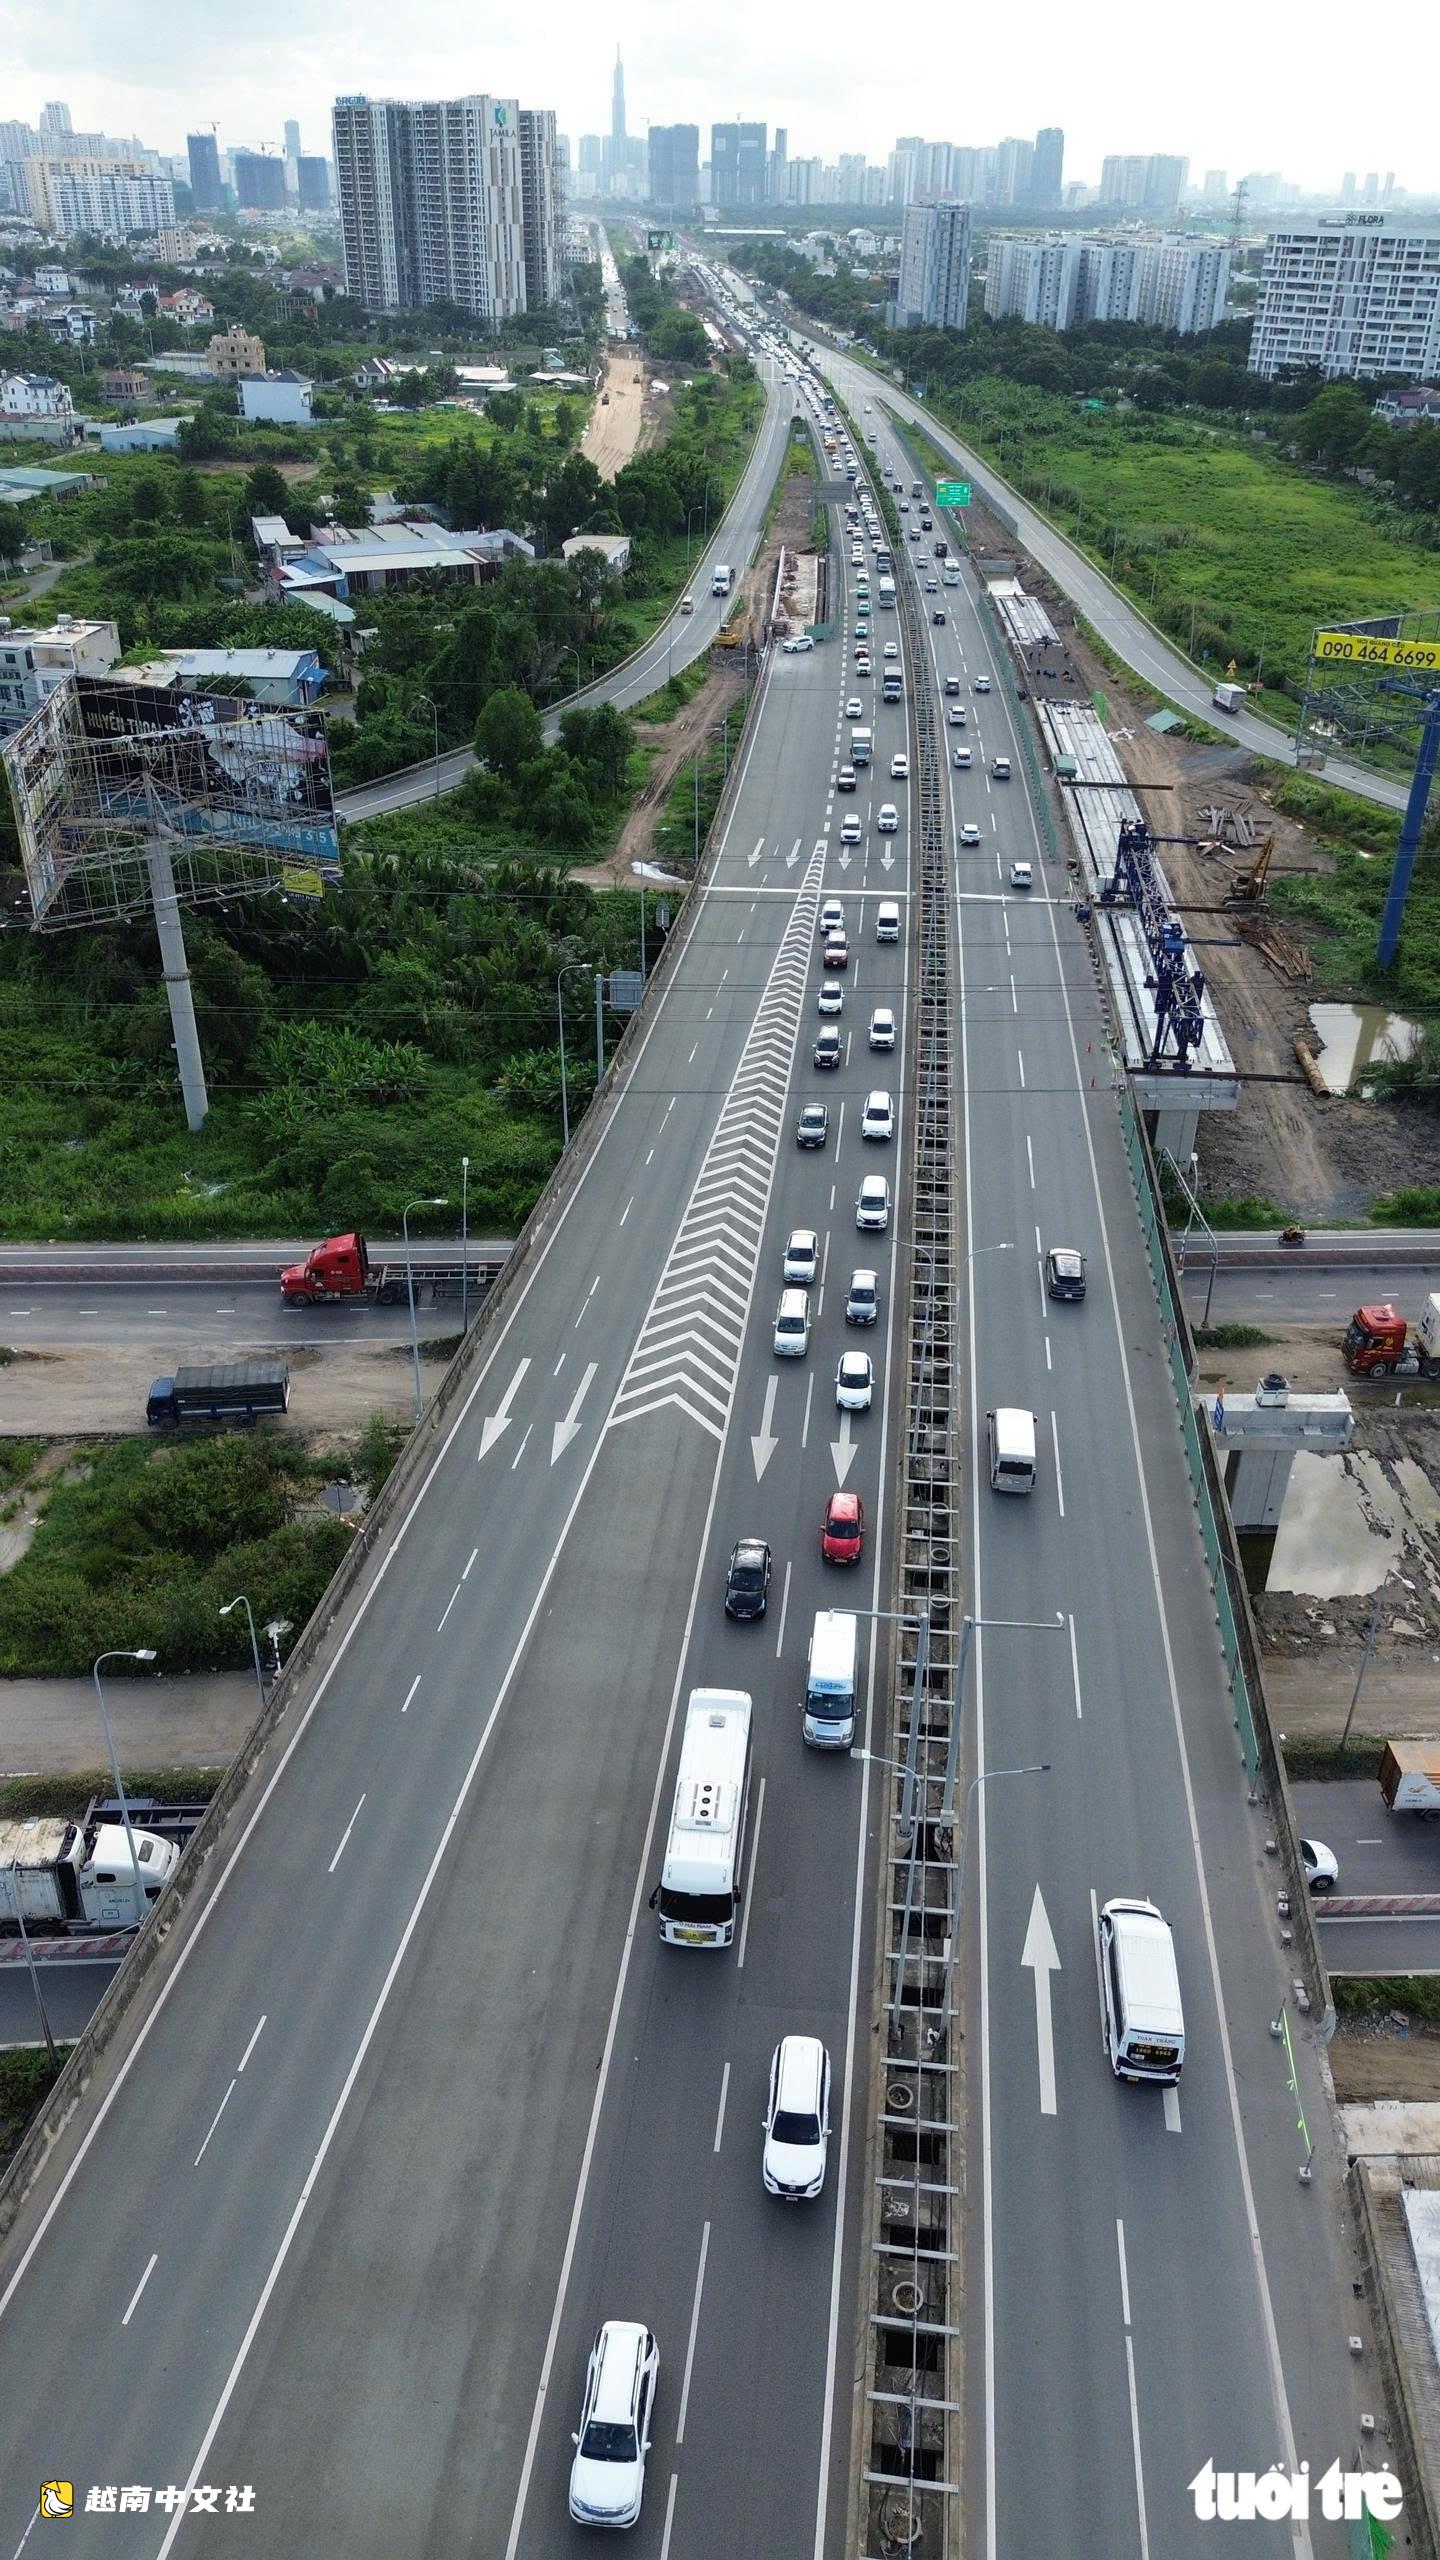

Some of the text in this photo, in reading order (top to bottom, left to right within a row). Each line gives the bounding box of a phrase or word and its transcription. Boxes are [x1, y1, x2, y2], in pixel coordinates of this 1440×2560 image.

[489, 129, 516, 144] JAMILA
[1359, 215, 1384, 224] FLORA
[1323, 641, 1436, 667] 090 464 6699
